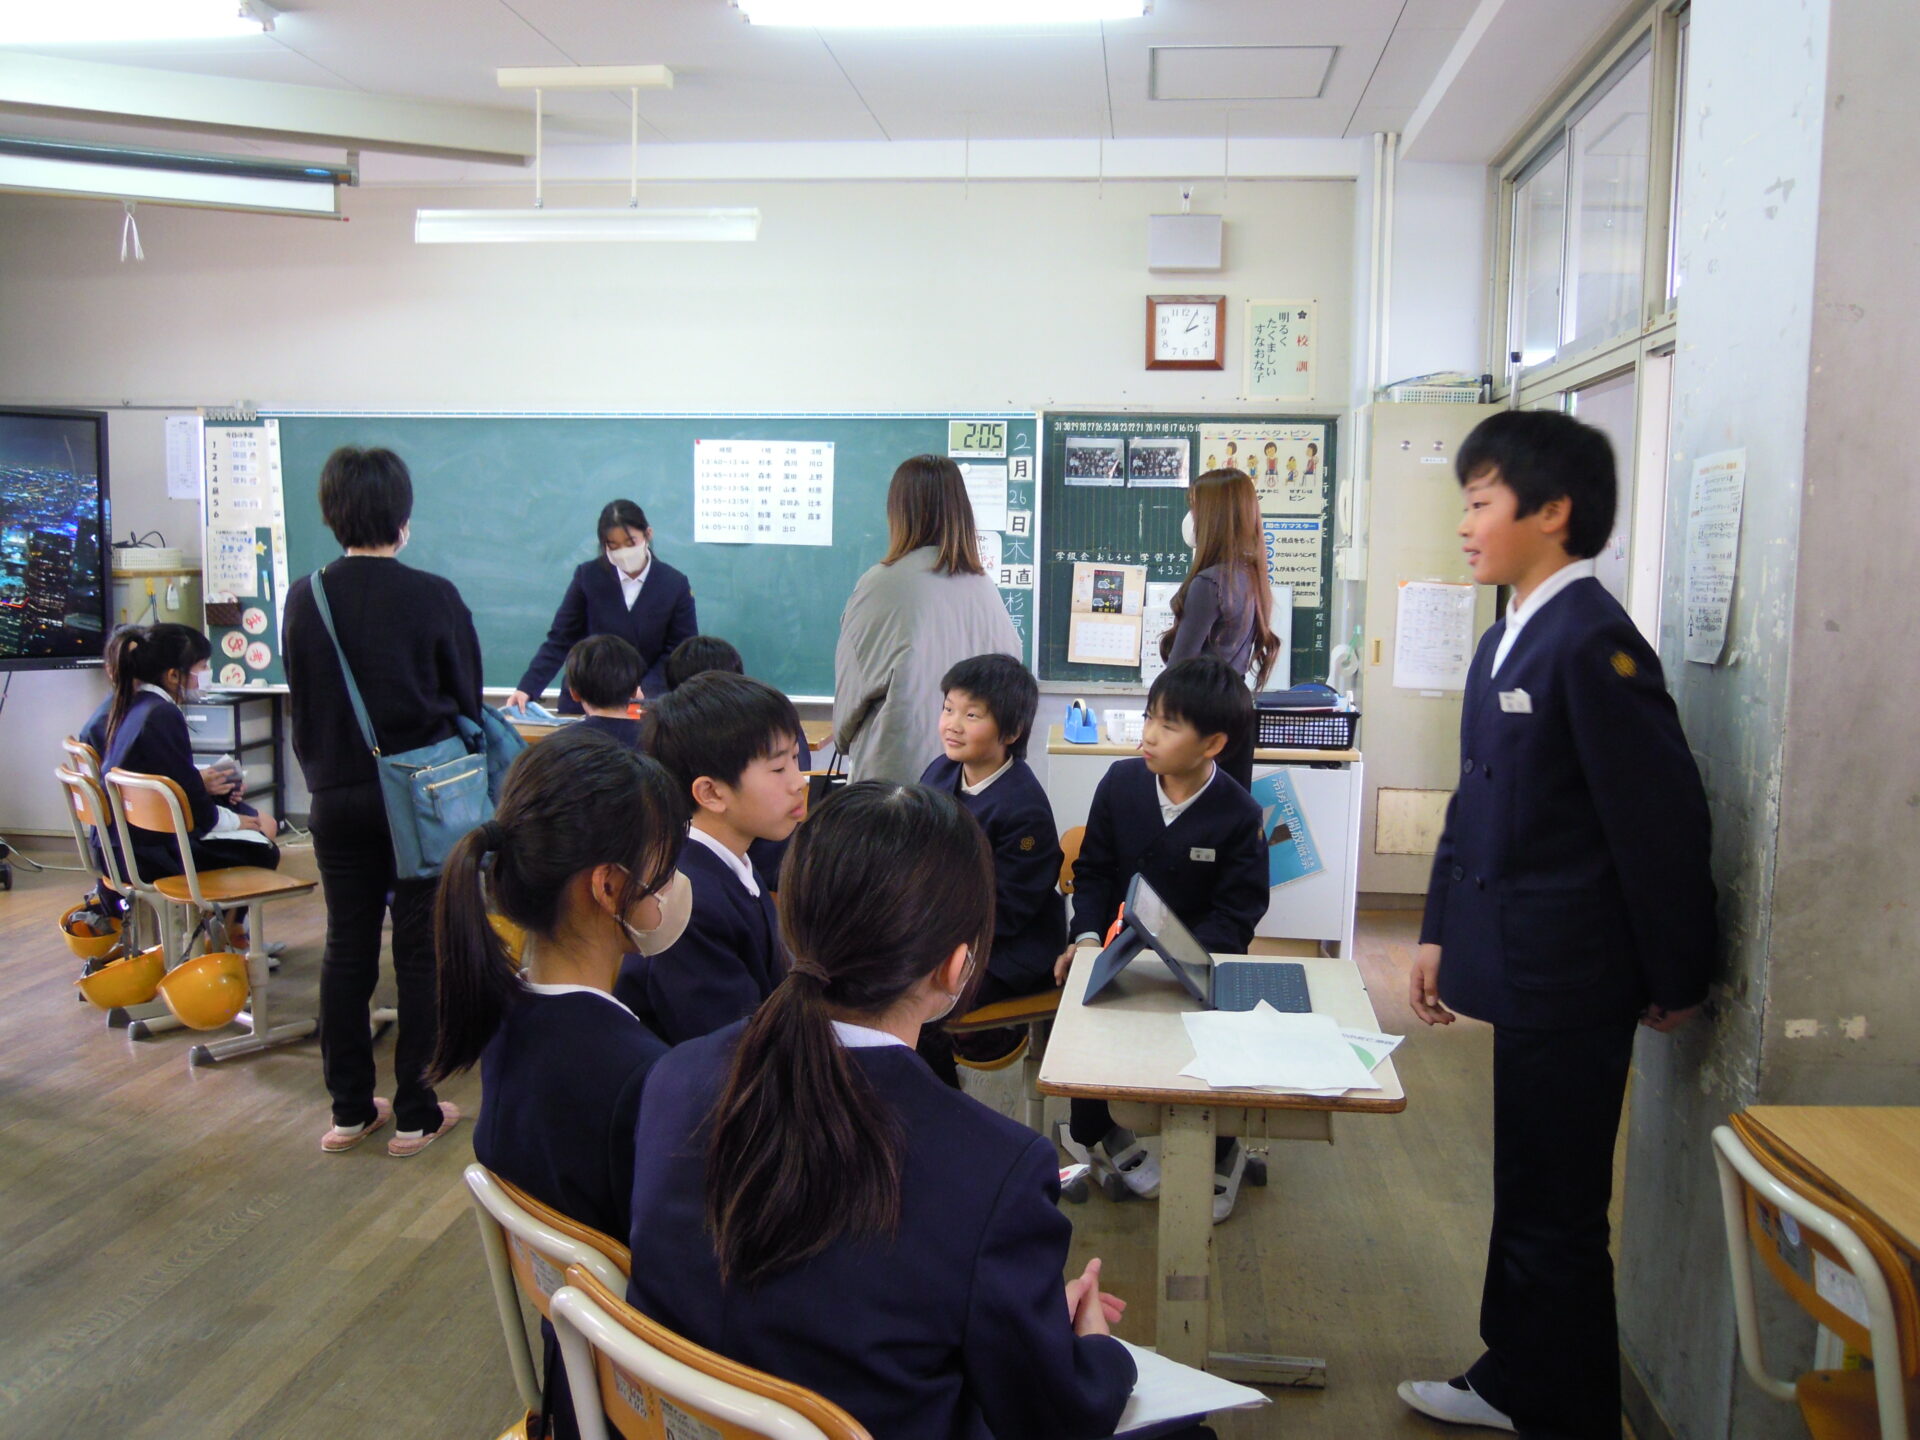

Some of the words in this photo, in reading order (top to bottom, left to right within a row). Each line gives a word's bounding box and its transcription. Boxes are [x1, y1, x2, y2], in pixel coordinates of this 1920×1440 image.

[1278, 312, 1290, 347] 明るく
[1254, 323, 1265, 384] すなおな子
[1265, 318, 1277, 377] たくましい
[1295, 335, 1309, 373] 校訓
[963, 423, 1003, 448] 2:05
[1054, 421, 1062, 431] 31
[1063, 421, 1071, 431] 30
[1071, 421, 1079, 431] 29
[1079, 421, 1087, 431] 28
[1087, 421, 1095, 431] 27
[1095, 422, 1103, 431] 26
[1103, 422, 1111, 431] 25
[1111, 422, 1119, 432] 24
[1119, 422, 1127, 432] 23
[1128, 422, 1136, 432] 22
[1136, 422, 1144, 432] 21
[1145, 422, 1153, 432] 20
[1154, 422, 1161, 432] 19
[1162, 423, 1169, 432] 18
[1170, 423, 1178, 432] 17
[1179, 423, 1187, 432] 16
[1187, 423, 1194, 432] 15
[1013, 433, 1031, 451] 2
[1014, 460, 1027, 478] 月
[1009, 489, 1027, 506] 26
[1012, 516, 1025, 533] 日
[1003, 539, 1030, 563] 木
[1055, 552, 1090, 561] 学級会
[1096, 553, 1132, 562] おしらせ
[1140, 552, 1188, 563] 学習予定
[1000, 568, 1032, 585] 日直
